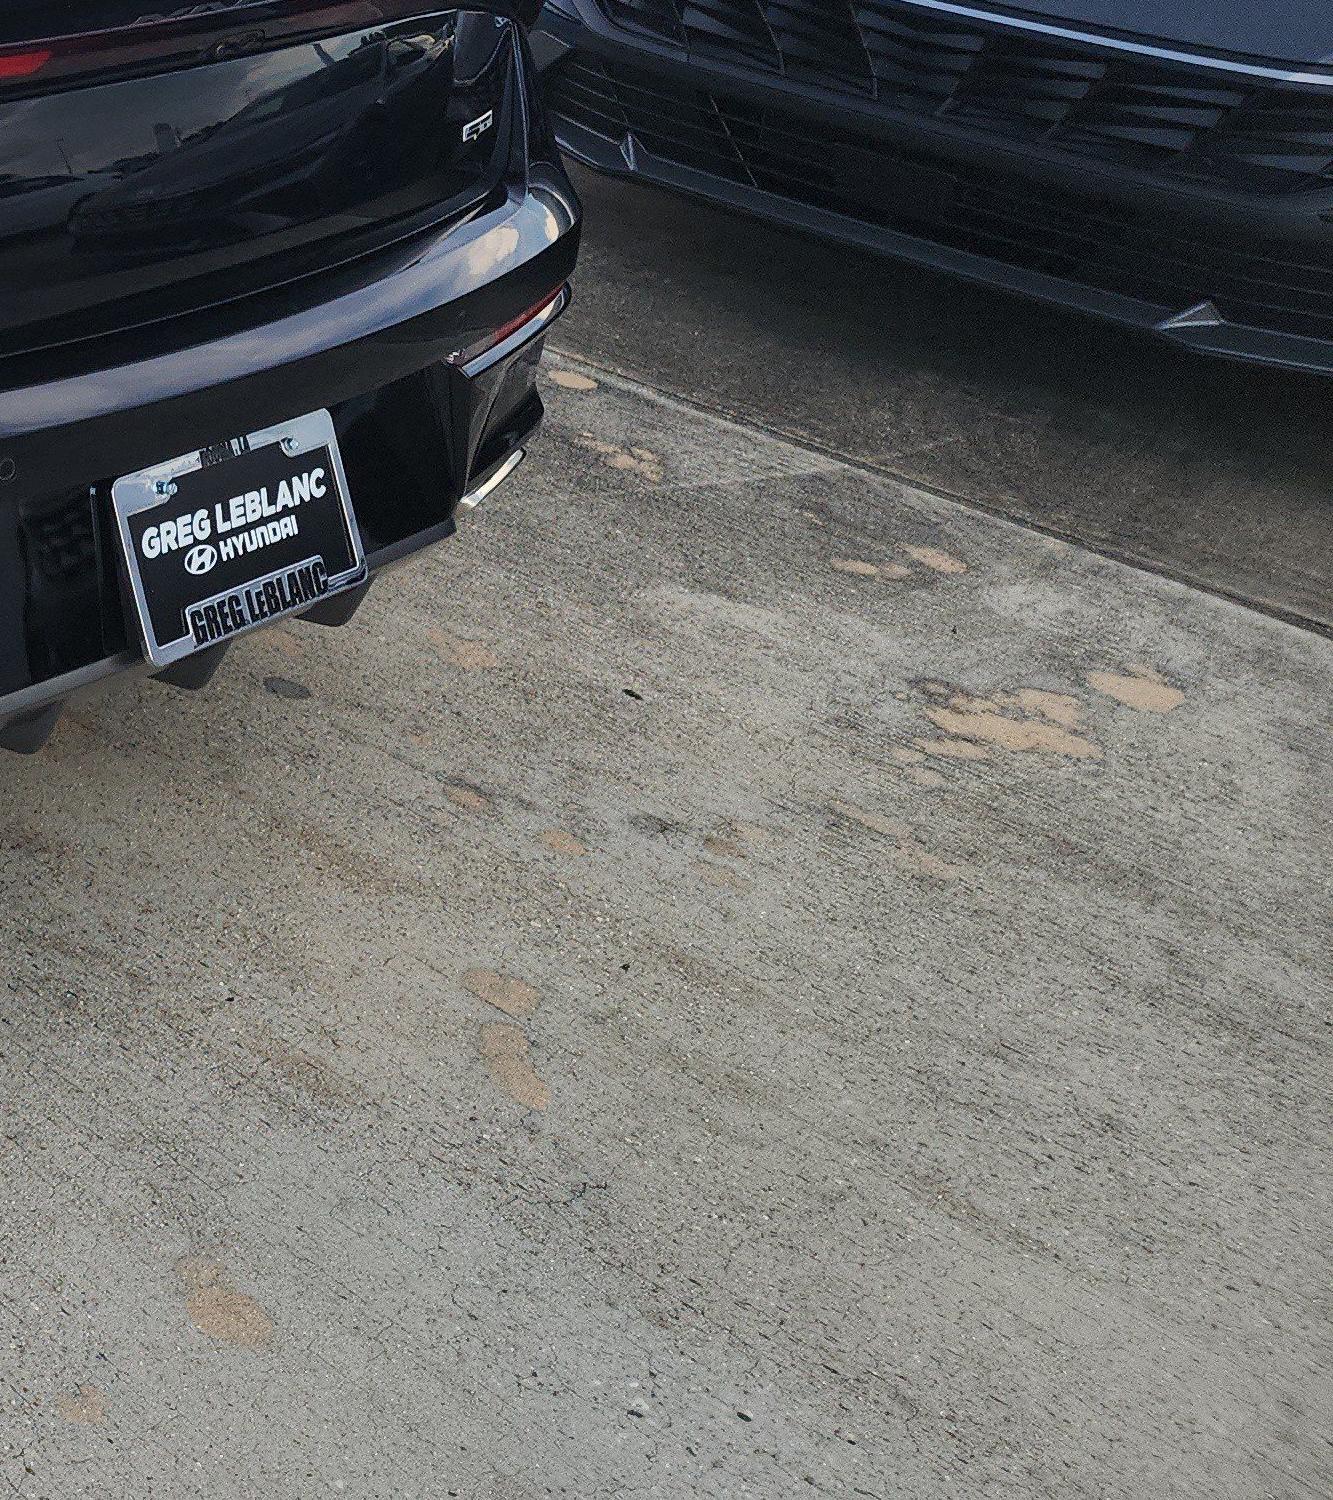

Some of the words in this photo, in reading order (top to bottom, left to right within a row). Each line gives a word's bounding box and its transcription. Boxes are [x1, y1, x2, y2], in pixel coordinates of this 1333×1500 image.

[141, 508, 212, 559] GREG
[215, 467, 327, 535] LEBLANC
[219, 514, 299, 563] HYUNDAI
[190, 594, 246, 645] GREG
